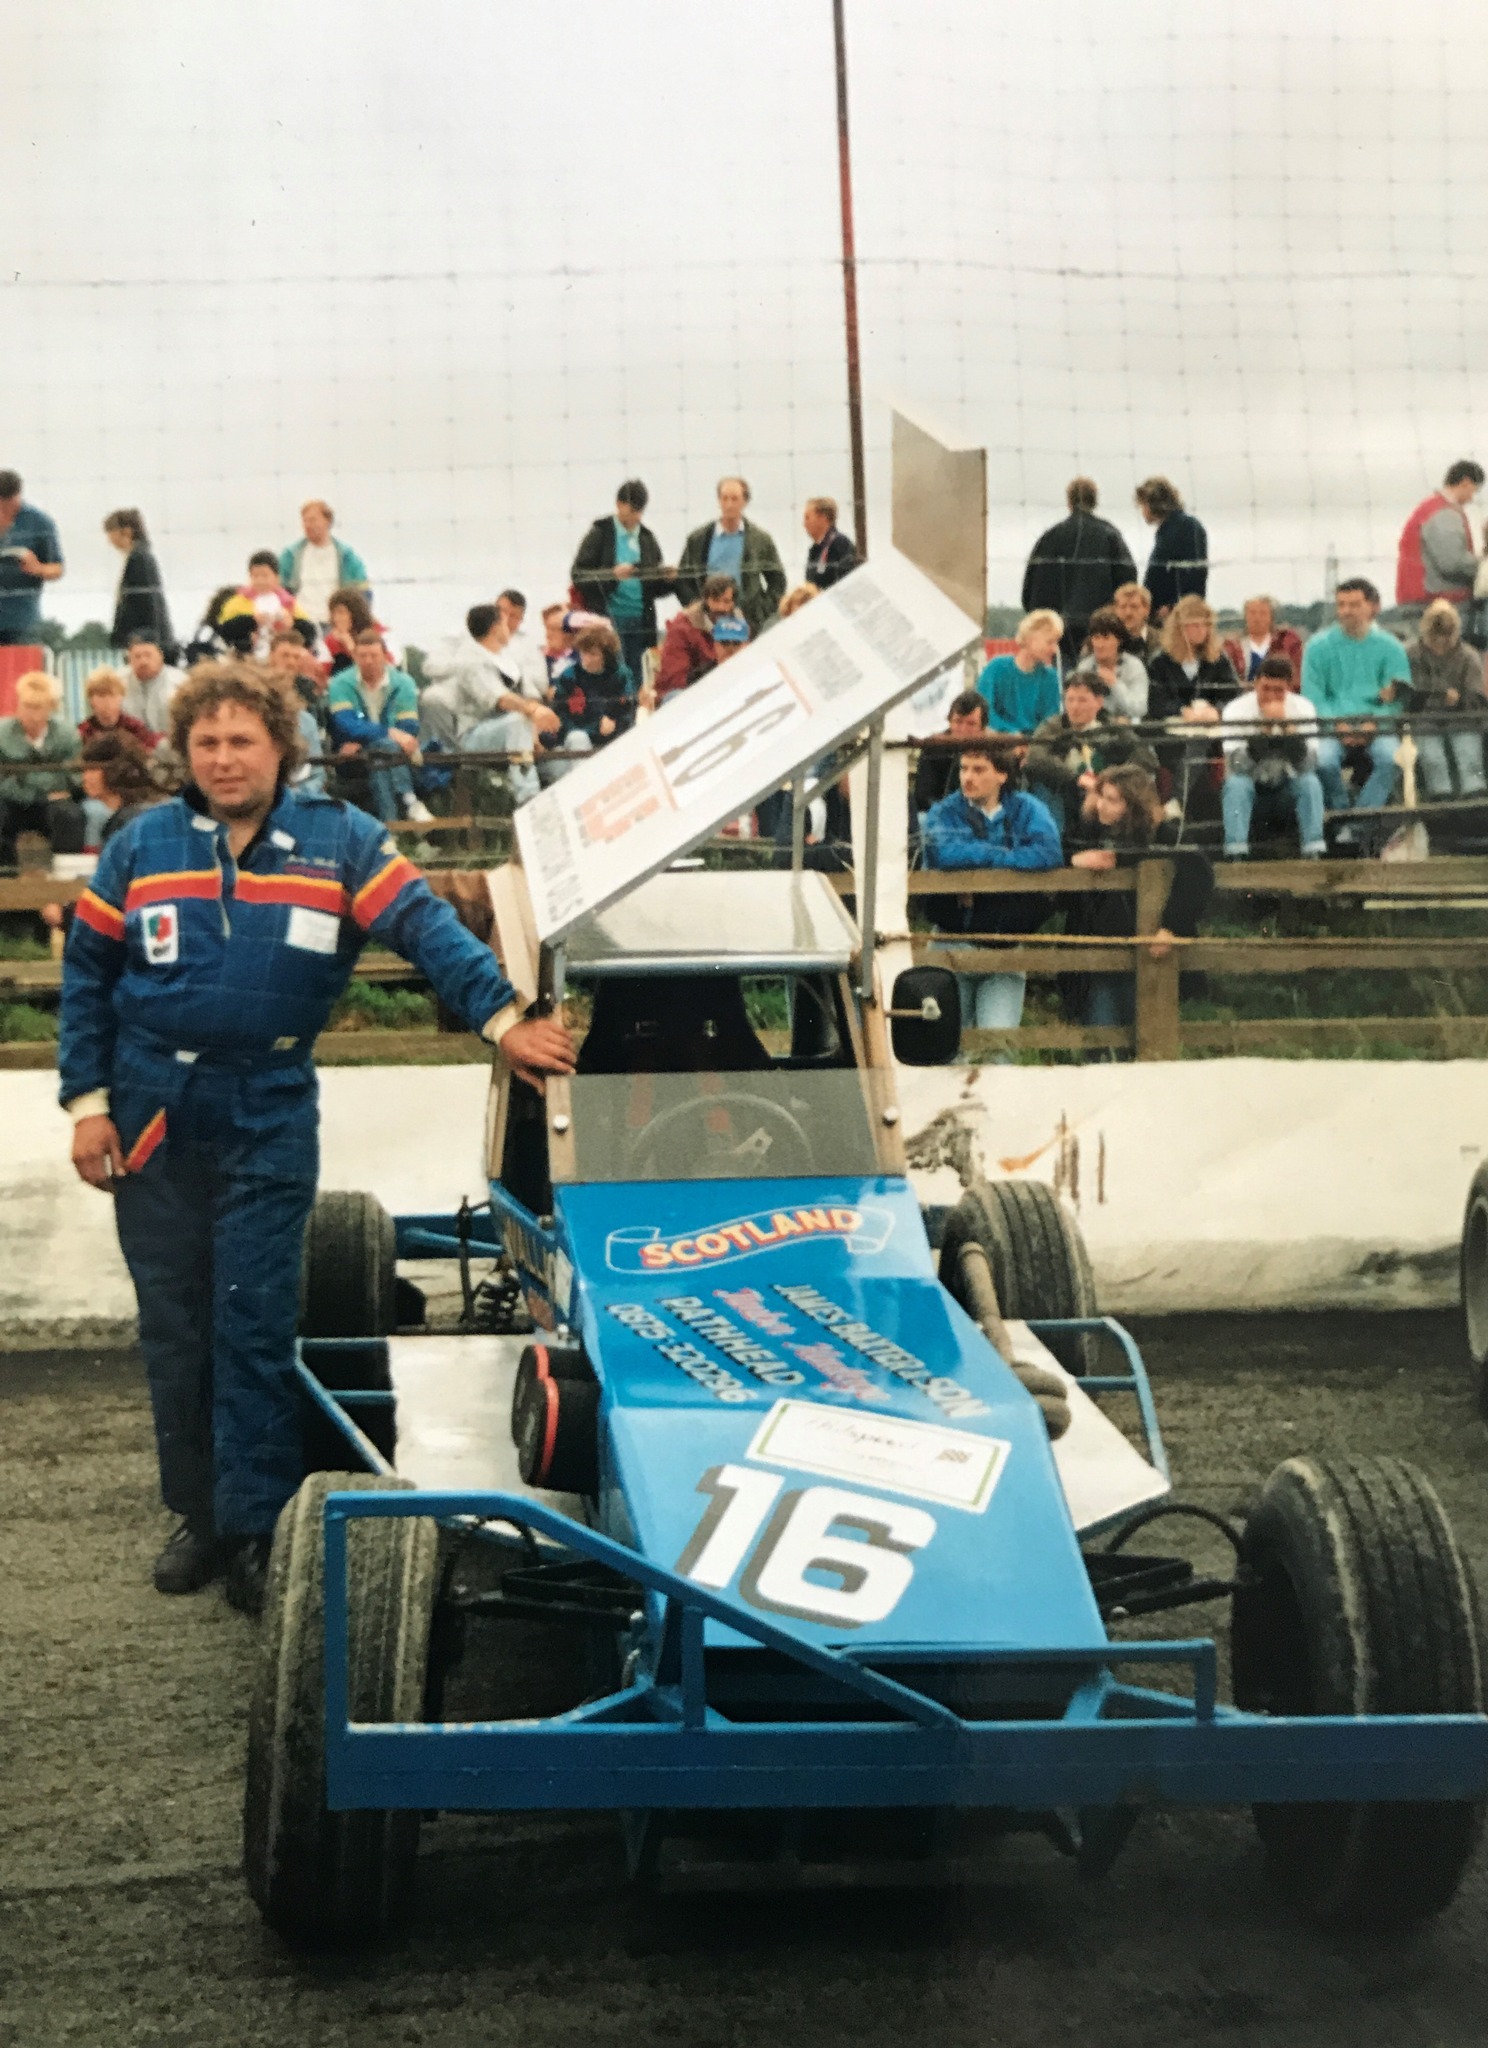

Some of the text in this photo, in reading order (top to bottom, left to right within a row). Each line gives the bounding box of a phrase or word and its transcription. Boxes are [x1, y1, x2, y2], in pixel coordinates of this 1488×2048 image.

[661, 680, 796, 787] 16
[640, 1208, 863, 1268] SCOTLAND
[657, 1296, 805, 1385] PATHHEAD
[911, 1377, 991, 1417] SON
[676, 1464, 937, 1628] 16
